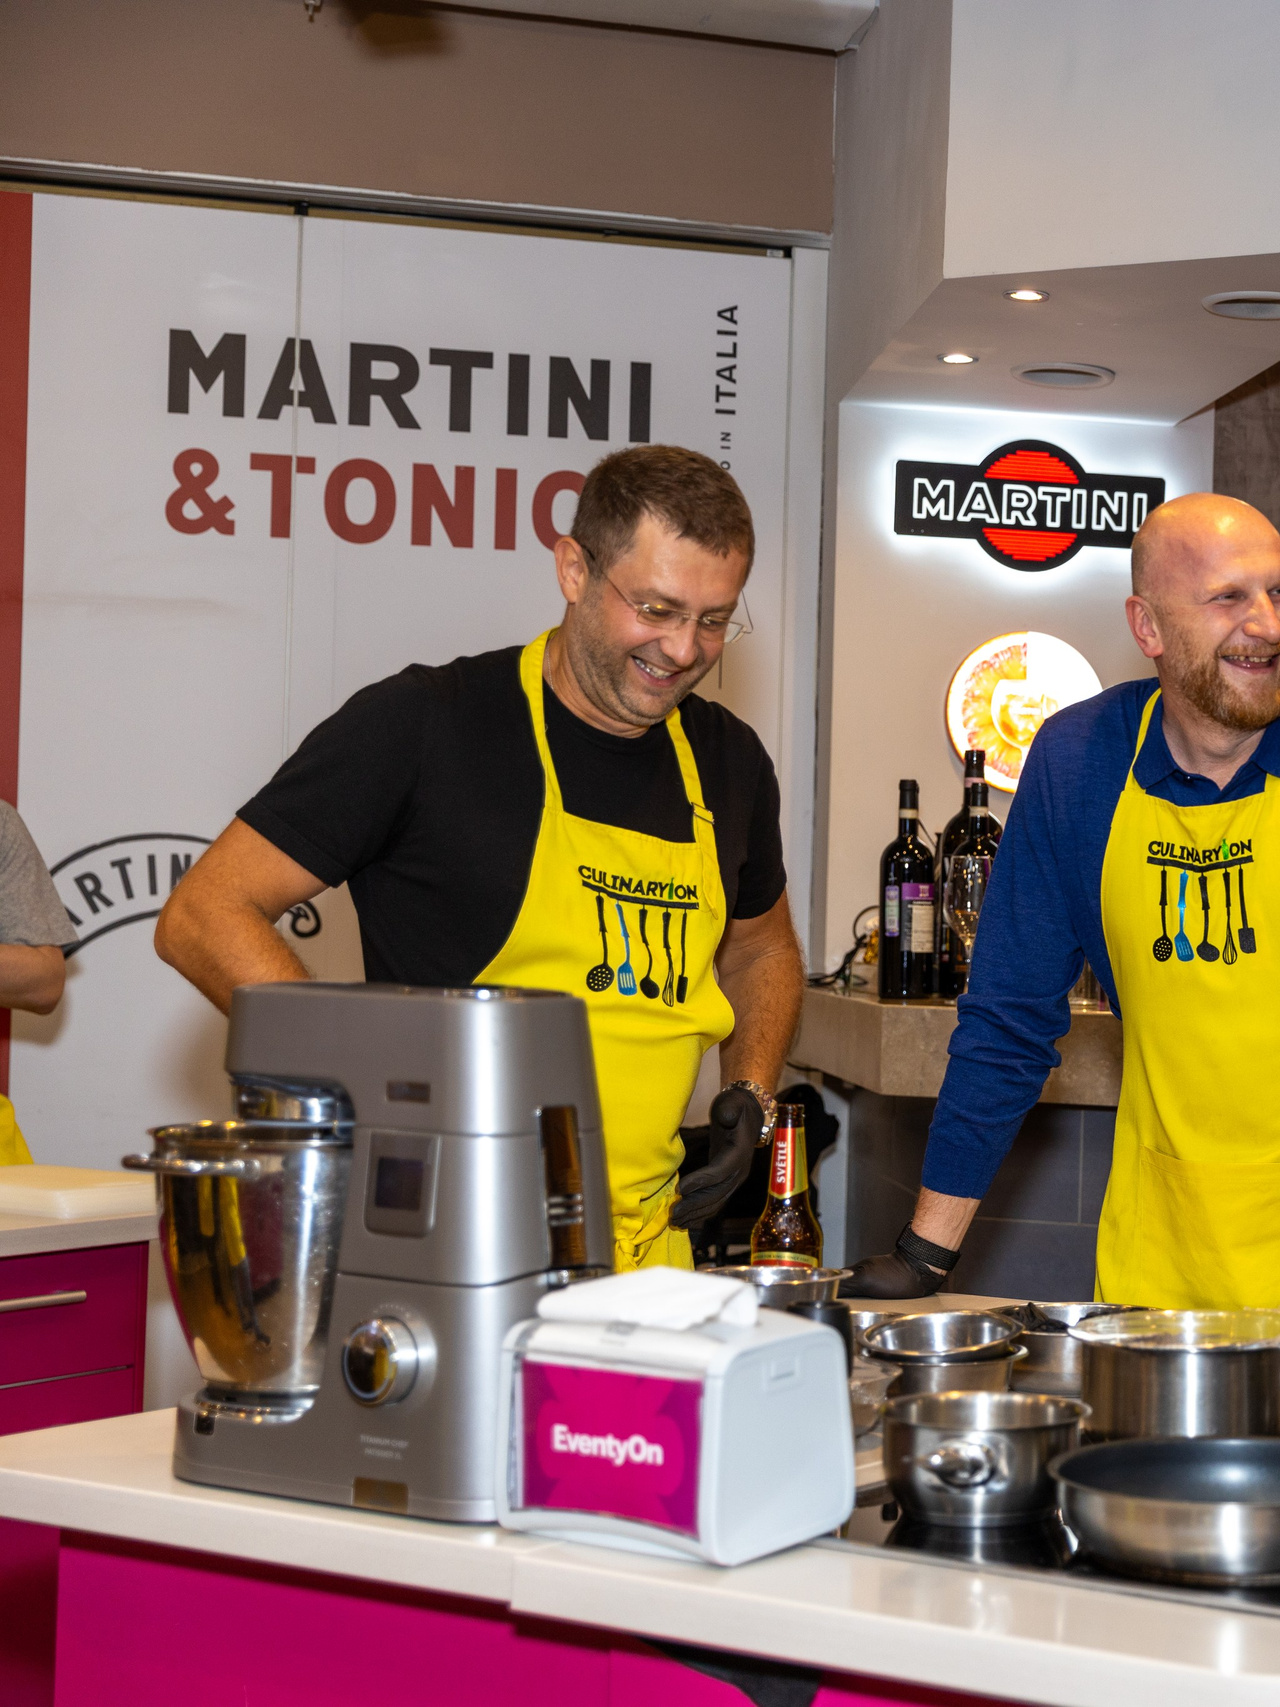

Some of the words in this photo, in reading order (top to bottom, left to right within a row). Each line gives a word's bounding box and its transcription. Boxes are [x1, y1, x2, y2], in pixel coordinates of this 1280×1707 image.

[715, 304, 738, 415] ITALIA
[166, 328, 652, 444] MARTINI
[720, 431, 731, 450] IN
[911, 477, 1148, 533] MARTINI
[776, 1140, 788, 1184] SVĚTLÉ
[551, 1422, 665, 1468] EventyOn
